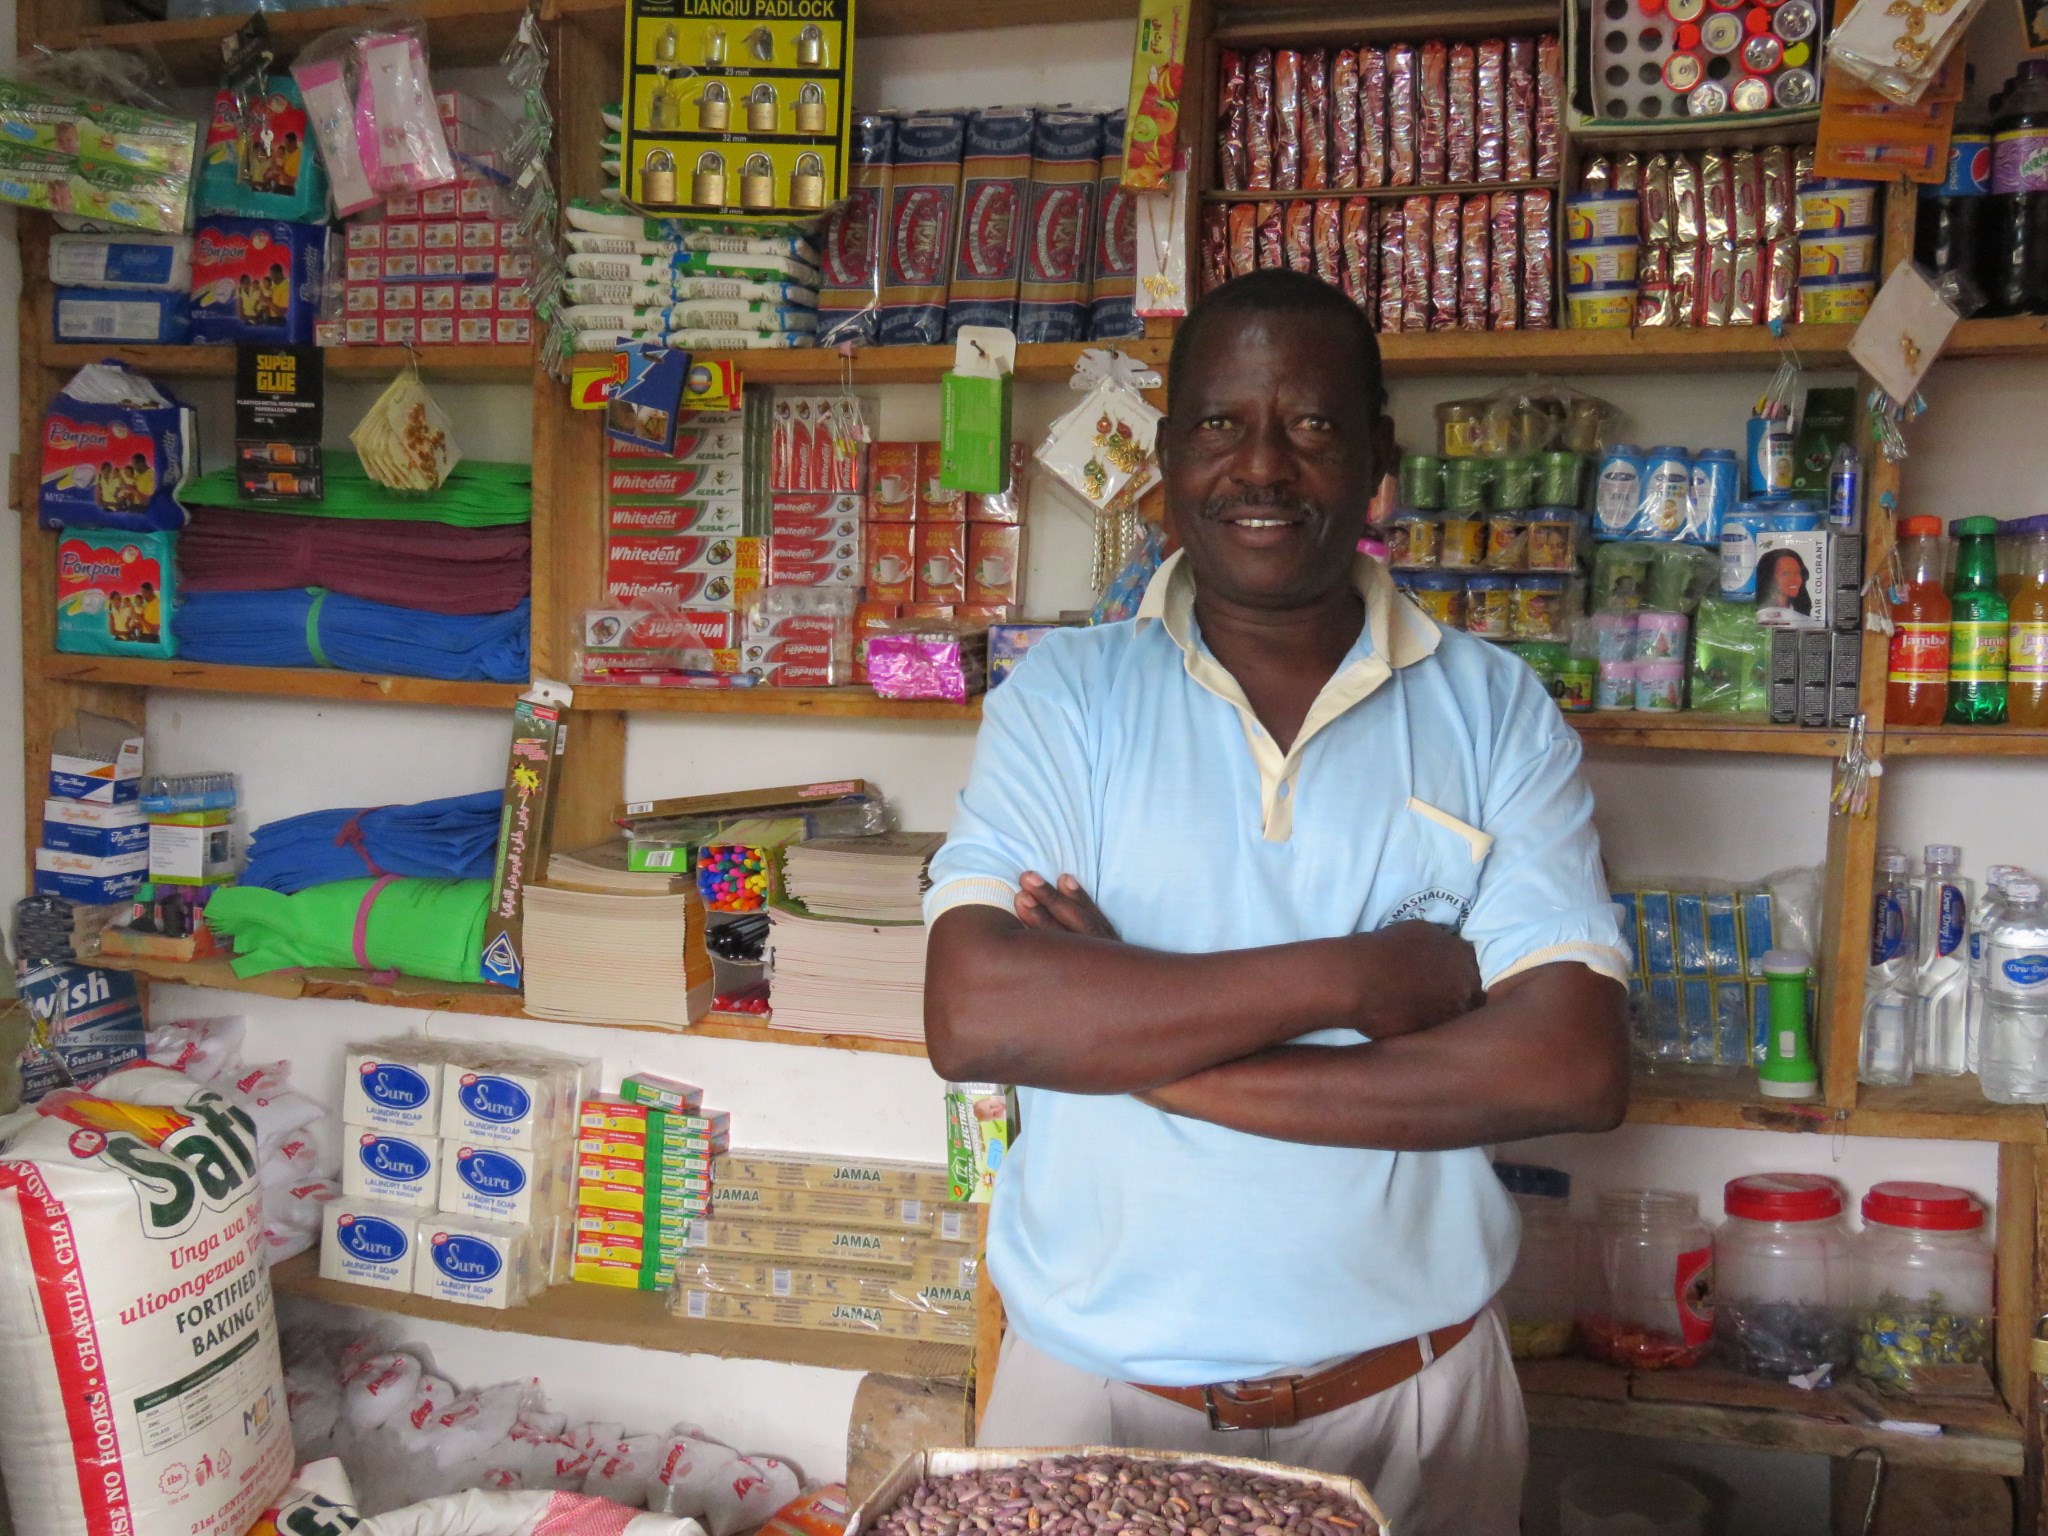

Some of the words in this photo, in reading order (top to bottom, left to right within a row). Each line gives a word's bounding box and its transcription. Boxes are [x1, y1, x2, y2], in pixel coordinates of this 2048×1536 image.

[683, 0, 750, 17] LIANQIU
[755, 0, 835, 18] PADLOCK
[256, 354, 297, 371] SUPER
[256, 371, 297, 392] GLUE
[613, 474, 678, 490] Whitedent
[696, 488, 725, 496] HERBAL
[773, 502, 817, 513] Whitedent
[612, 510, 678, 526] Whitedent
[773, 526, 817, 536] Whitedent
[611, 545, 682, 562] Whitedent
[773, 548, 815, 558] Whitedent
[773, 570, 815, 580] Whitedent
[1814, 541, 1823, 595] COLORANT
[1814, 598, 1823, 622] HAIR
[649, 621, 724, 639] Whitedent
[1392, 890, 1460, 920] MASHAURI
[374, 1072, 414, 1104] Sura
[474, 1083, 514, 1117] Sura
[366, 1106, 400, 1119] LAUNDRY
[401, 1111, 423, 1121] SOAP
[463, 1119, 498, 1132] LAUNDRY
[500, 1125, 521, 1135] SOAP
[957, 1101, 972, 1151] ELECTRIC
[375, 1143, 415, 1175] Sura
[471, 1157, 510, 1190] Sura
[833, 1167, 882, 1182] JAMAA
[364, 1178, 401, 1190] LAUNDRY
[402, 1184, 423, 1193] SOAP
[462, 1191, 496, 1204] LAUNDRY
[496, 1198, 517, 1209] SOAP
[713, 1188, 760, 1202] JAMAA
[50, 1220, 75, 1265] CHA
[170, 1233, 220, 1270] Unga
[223, 1217, 246, 1242] wa
[351, 1223, 392, 1257] Sura
[832, 1233, 882, 1250] JAMAA
[341, 1259, 377, 1272] LAUNDRY
[378, 1266, 399, 1276] SOAP
[445, 1242, 485, 1275] Sura
[119, 1250, 246, 1326] ulioongezwa
[435, 1279, 471, 1292] LAUNDRY
[473, 1285, 494, 1295] SOAP
[920, 1284, 972, 1302] JAMAA
[175, 1268, 257, 1335] FORTIFIED
[62, 1267, 99, 1372] CHAKULA
[831, 1305, 883, 1323] JAMAA
[191, 1301, 255, 1358] BAKING
[91, 1391, 118, 1467] HOOKS
[103, 1471, 124, 1504] NO
[166, 1473, 183, 1486] tbs
[191, 1514, 217, 1535] 21st
